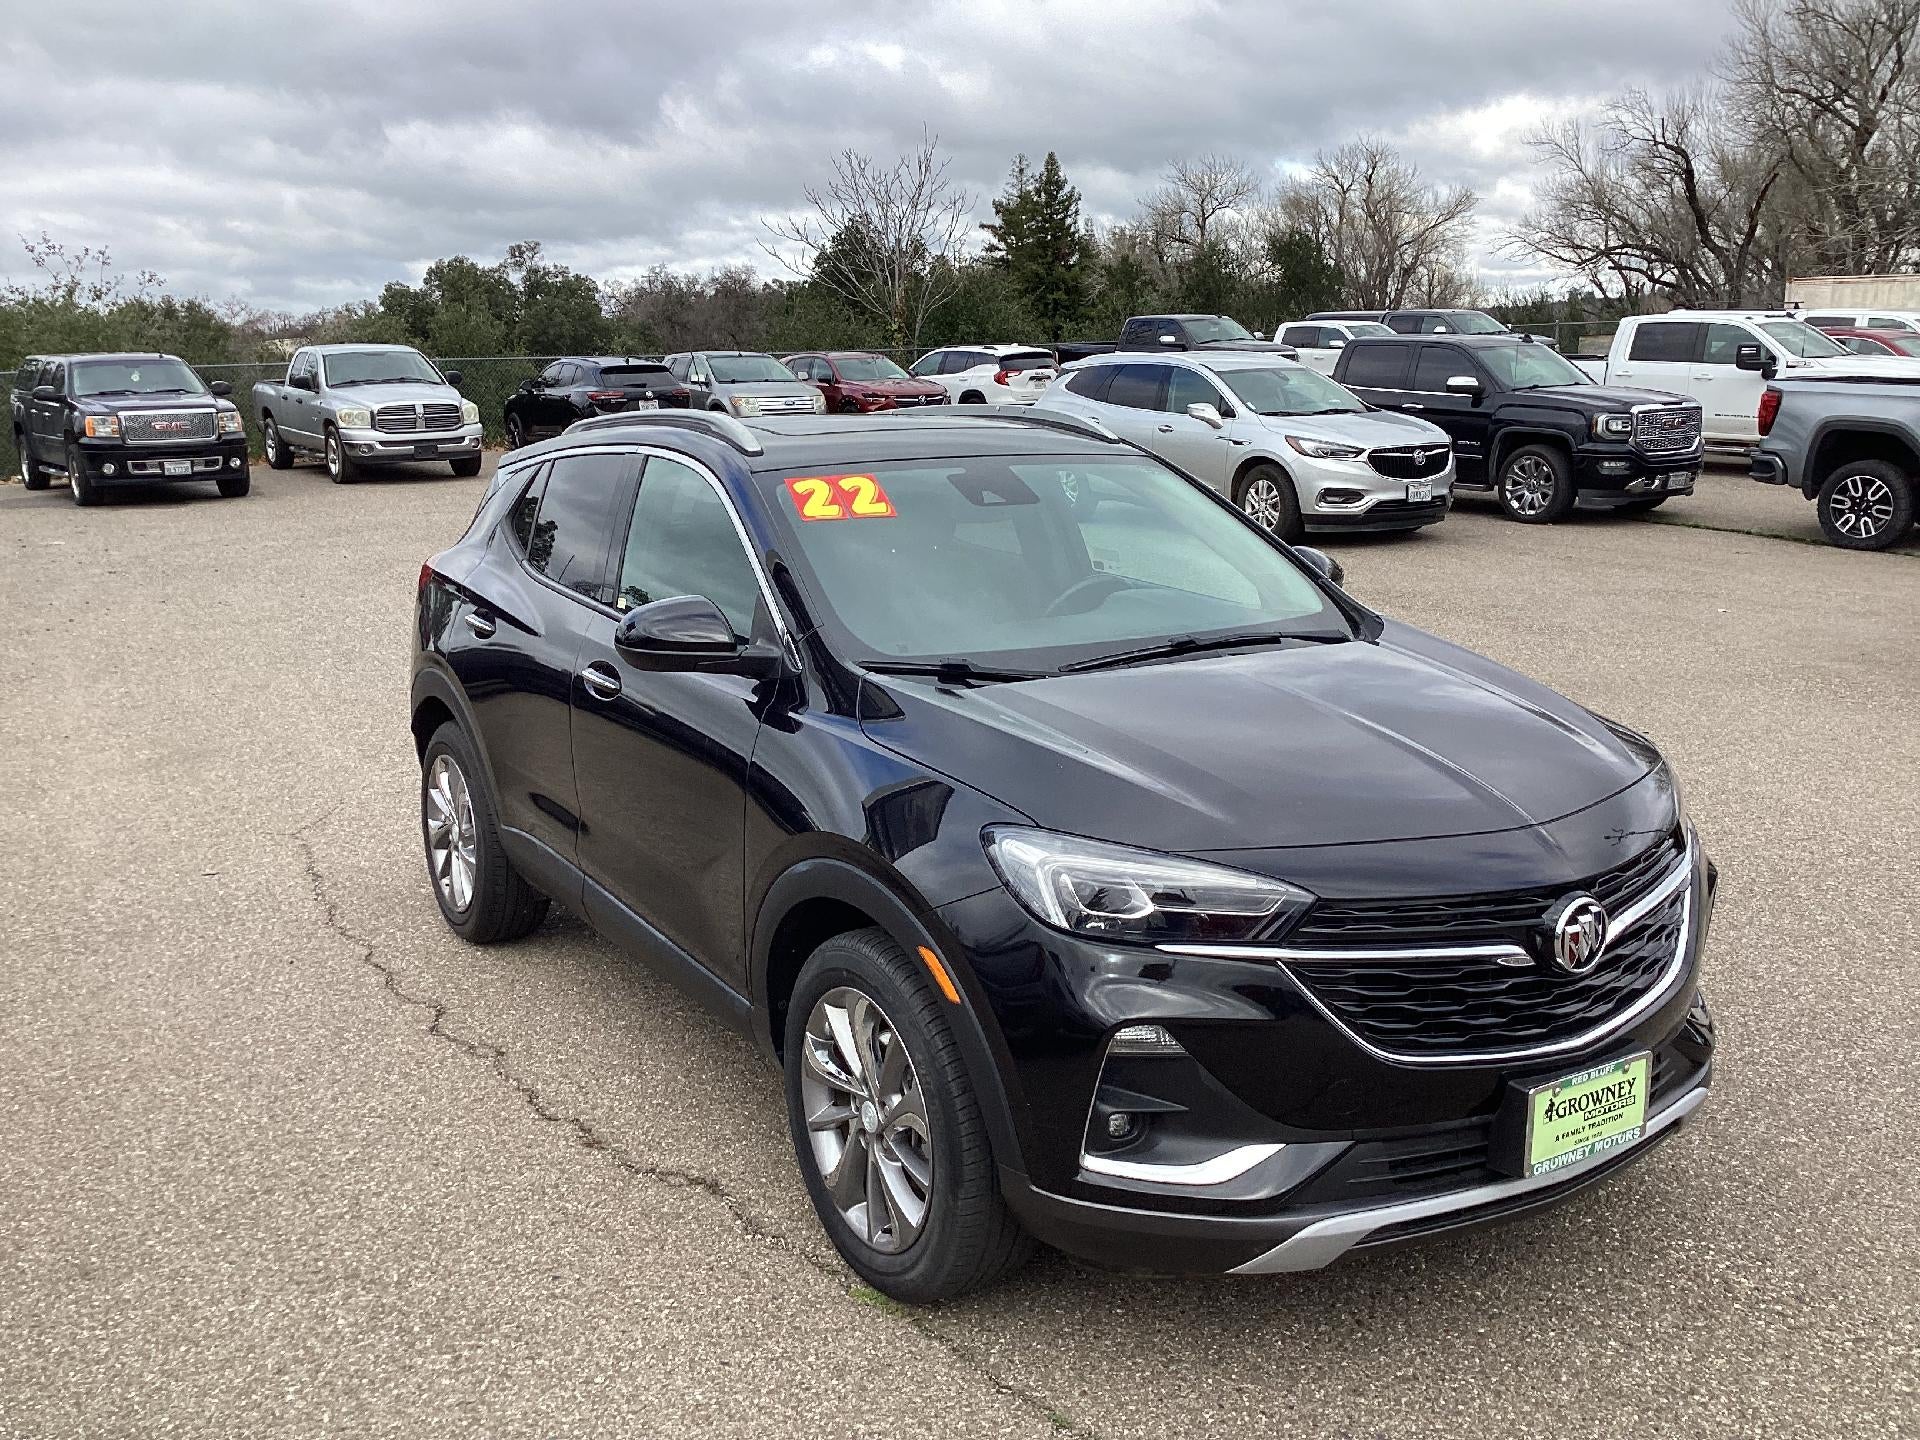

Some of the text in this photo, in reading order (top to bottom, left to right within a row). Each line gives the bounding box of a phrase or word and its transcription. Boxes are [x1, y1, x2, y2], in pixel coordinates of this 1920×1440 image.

[151, 421, 191, 431] GMC
[791, 476, 892, 519] 22
[1571, 1064, 1616, 1086] RED BLUFF
[1555, 1077, 1637, 1118] GROWNEY
[1584, 1095, 1635, 1120] MOTORS
[1555, 1112, 1624, 1143] A FAMILY TRADITION
[1574, 1136, 1590, 1146] SINCE
[1533, 1127, 1641, 1176] GROWNEY MOTORS
